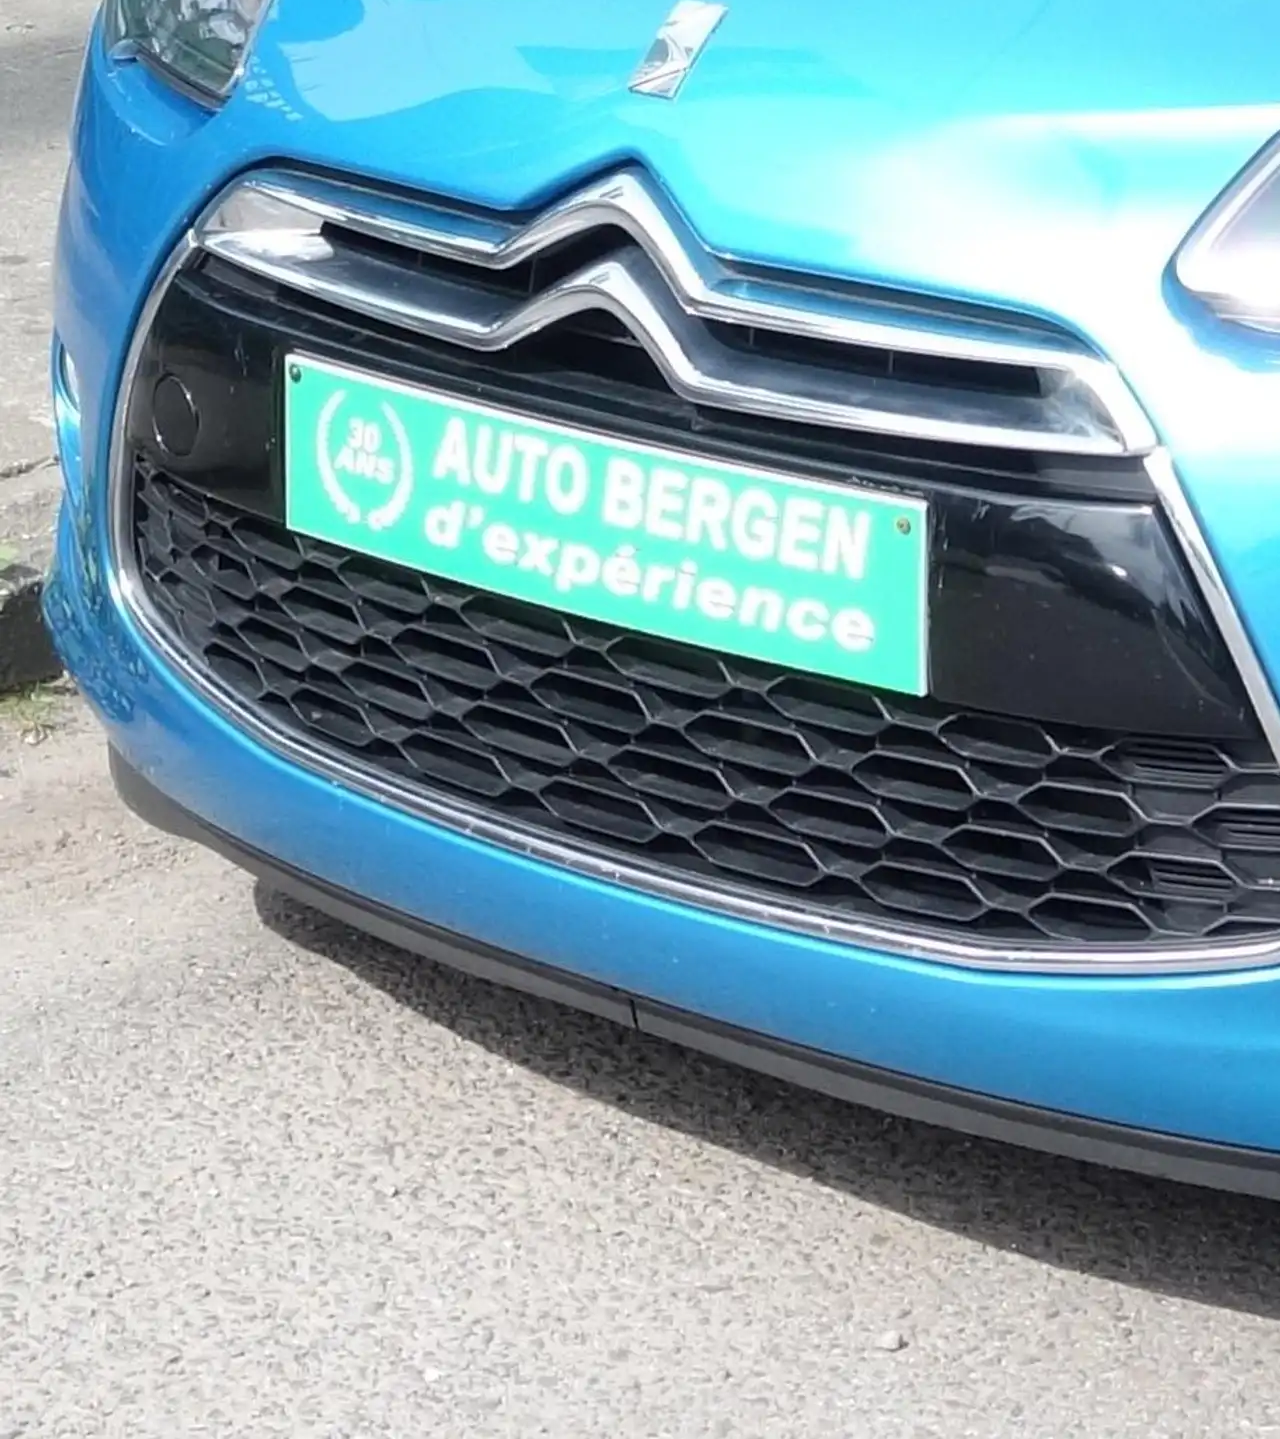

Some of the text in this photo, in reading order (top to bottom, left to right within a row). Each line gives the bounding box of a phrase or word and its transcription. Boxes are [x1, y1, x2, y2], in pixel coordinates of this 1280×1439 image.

[334, 452, 395, 485] ANS
[347, 417, 381, 450] 30
[432, 417, 873, 580] AUTO BERGEN
[424, 502, 876, 652] d'expérience
